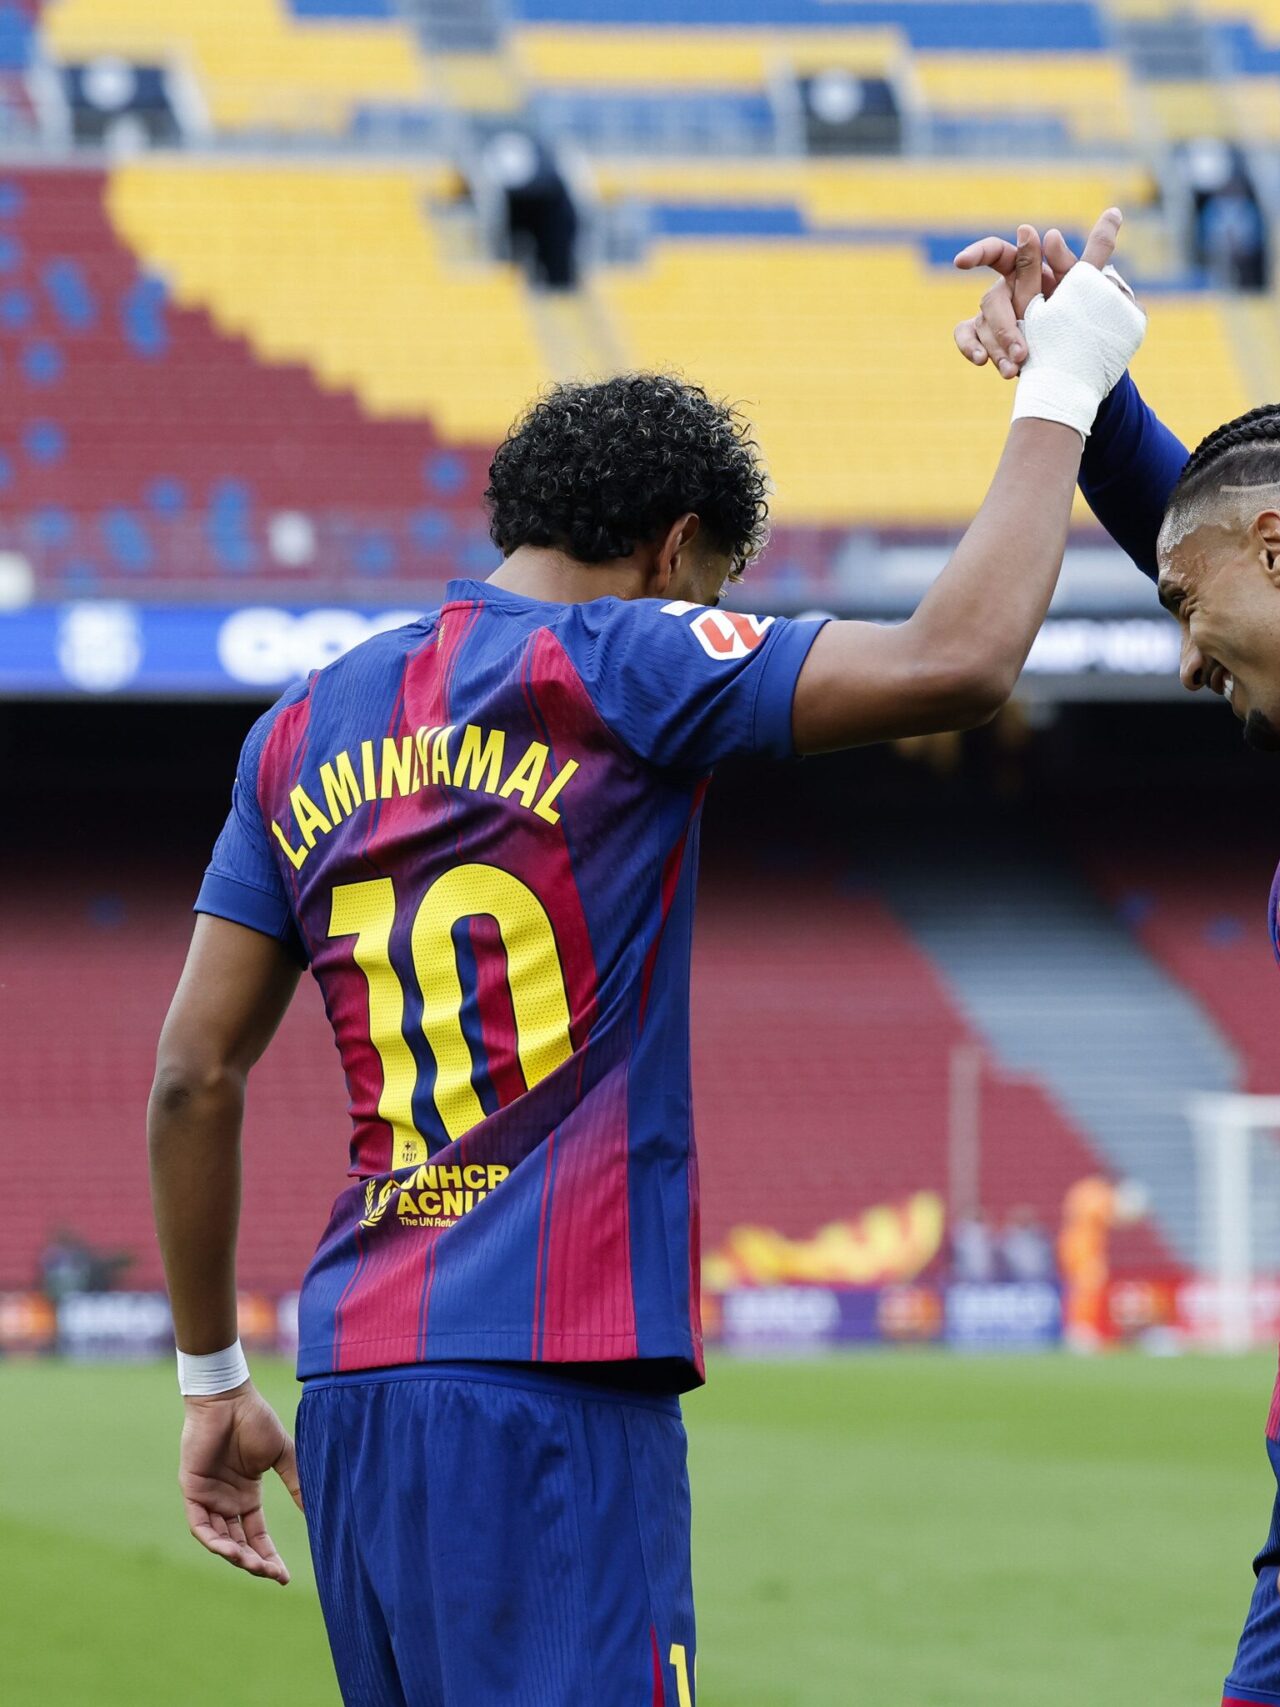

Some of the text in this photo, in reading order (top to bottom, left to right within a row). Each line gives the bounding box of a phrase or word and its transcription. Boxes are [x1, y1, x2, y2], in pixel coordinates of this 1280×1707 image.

[415, 724, 580, 826] YAMAL
[327, 863, 575, 1172] 10
[398, 1216, 418, 1226] The
[419, 1216, 433, 1227] UN
